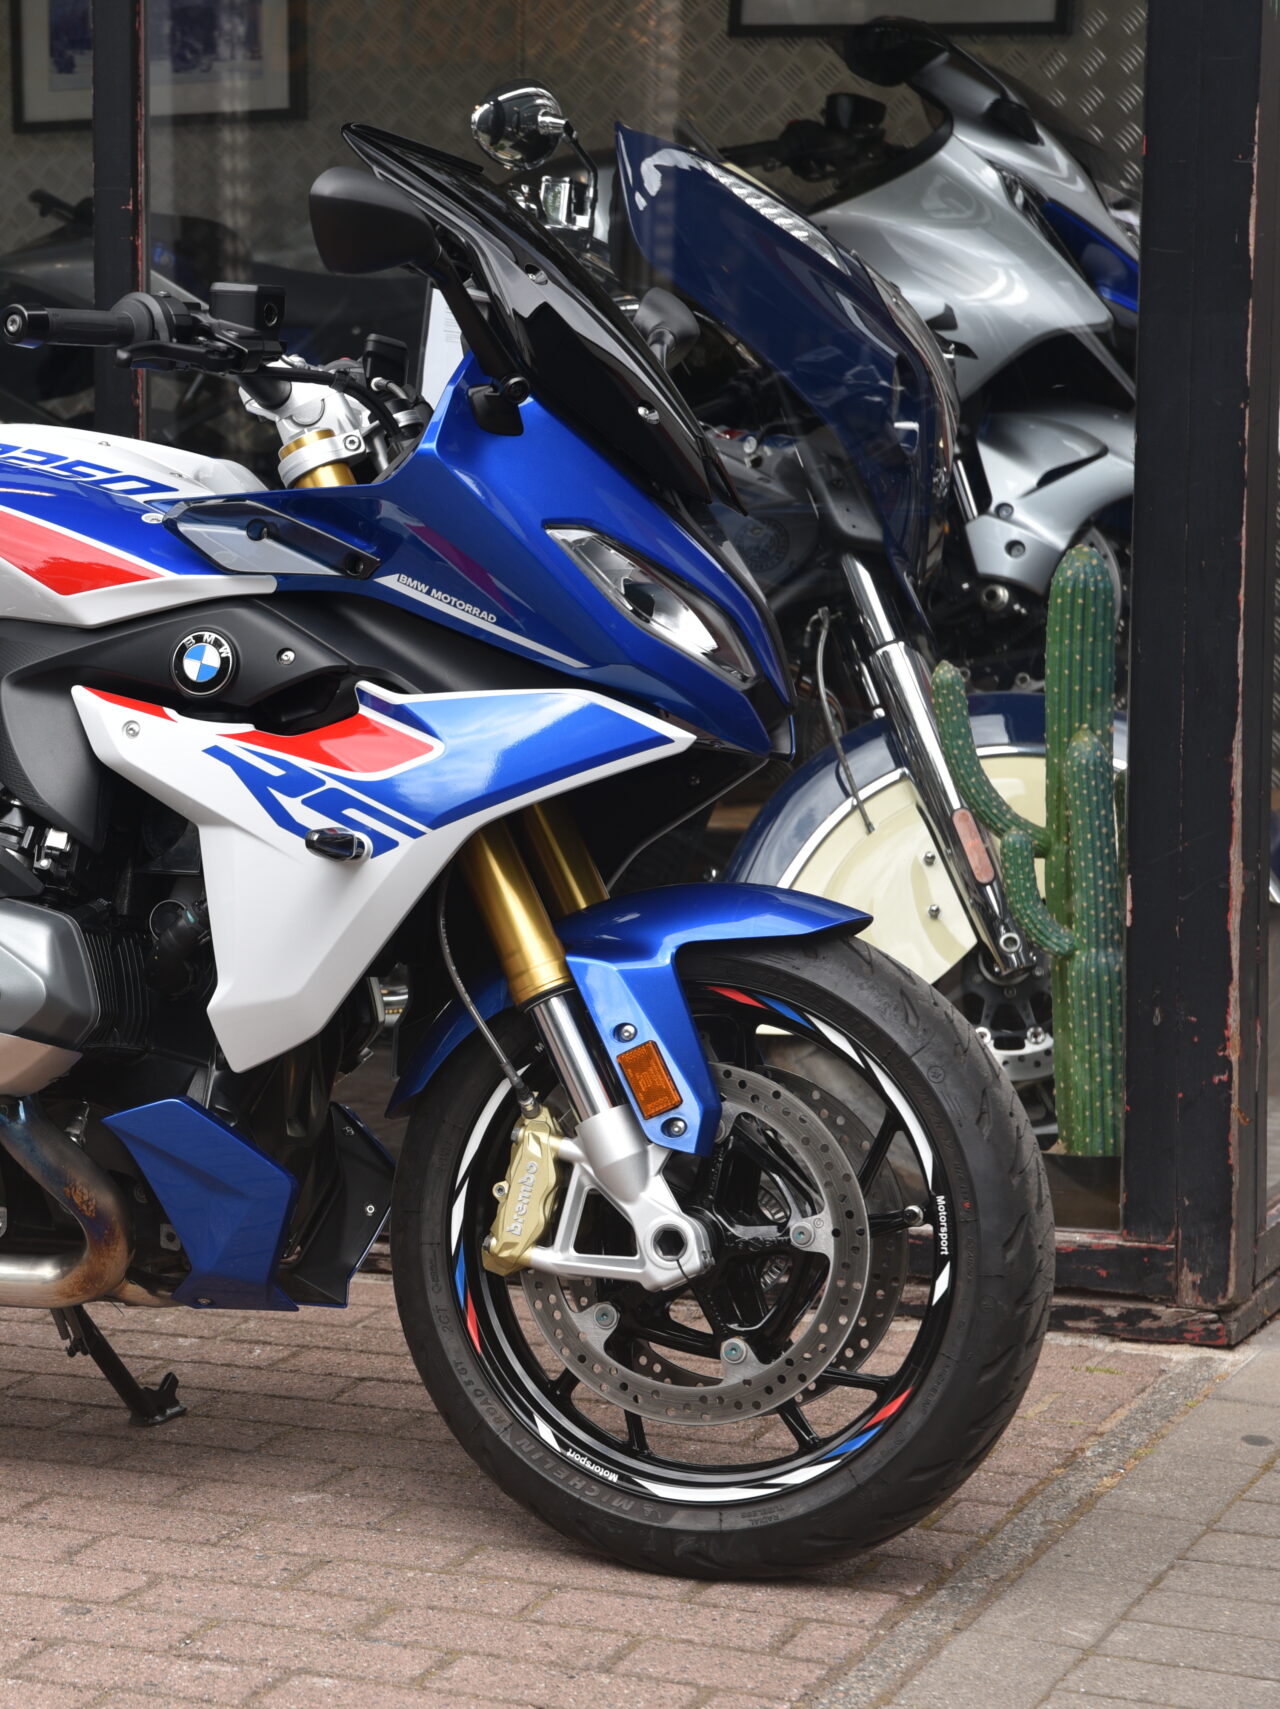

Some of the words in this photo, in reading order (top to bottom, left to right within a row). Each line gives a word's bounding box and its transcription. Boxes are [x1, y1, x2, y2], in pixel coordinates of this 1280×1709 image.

[399, 573, 429, 594] BMW
[430, 588, 497, 623] MOTORRAD
[183, 633, 231, 658] BMW
[204, 744, 428, 860] RS
[505, 1161, 538, 1236] brembo
[936, 1195, 949, 1255] Motorsport
[515, 1439, 636, 1512] MICHELIN
[567, 1448, 619, 1483] Motorsport
